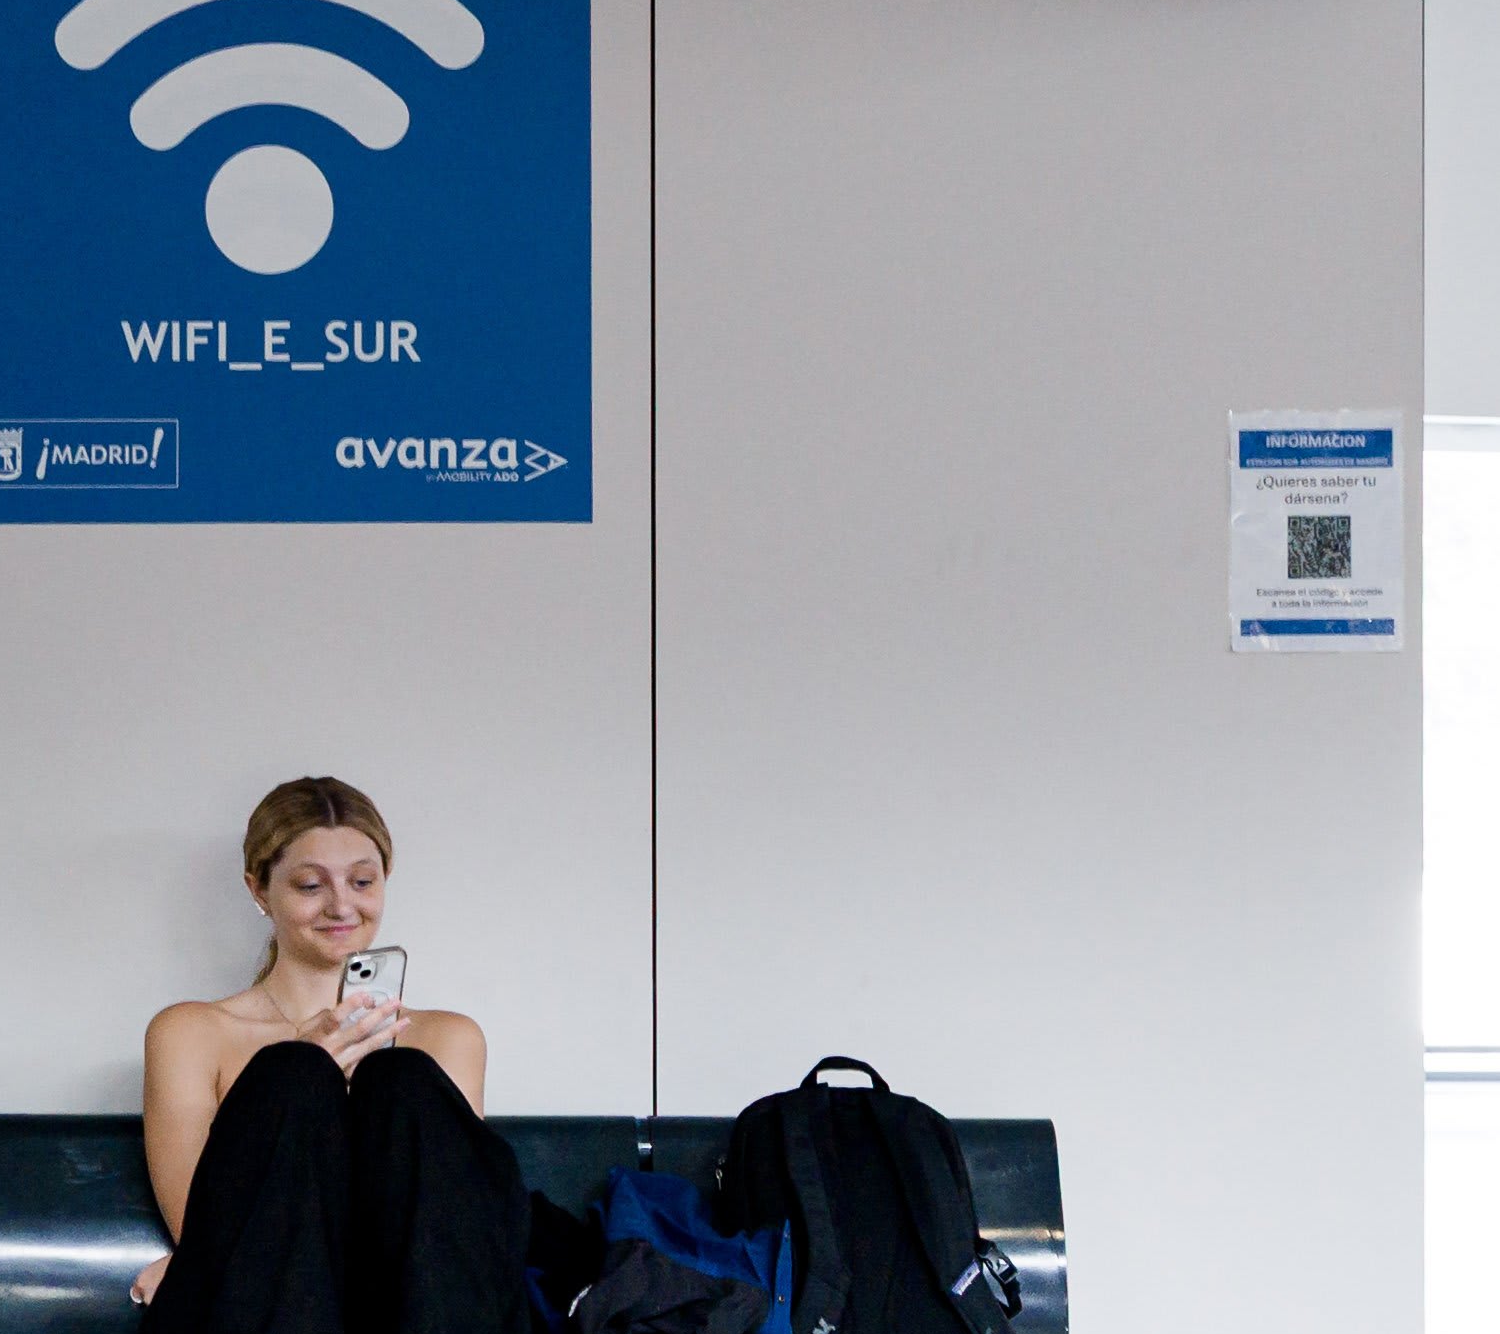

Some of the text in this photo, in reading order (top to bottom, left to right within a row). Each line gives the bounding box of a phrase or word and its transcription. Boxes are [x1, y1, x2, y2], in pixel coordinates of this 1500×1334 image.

[120, 319, 421, 371] WIFI_E_SUR
[36, 426, 165, 481] ¡MADRID!
[336, 436, 520, 471] avanza
[436, 470, 492, 483] MOBILITY
[494, 471, 520, 483] ADO
[1255, 474, 1377, 490] ¿Quieres saber tu
[1285, 491, 1349, 505] dársena?
